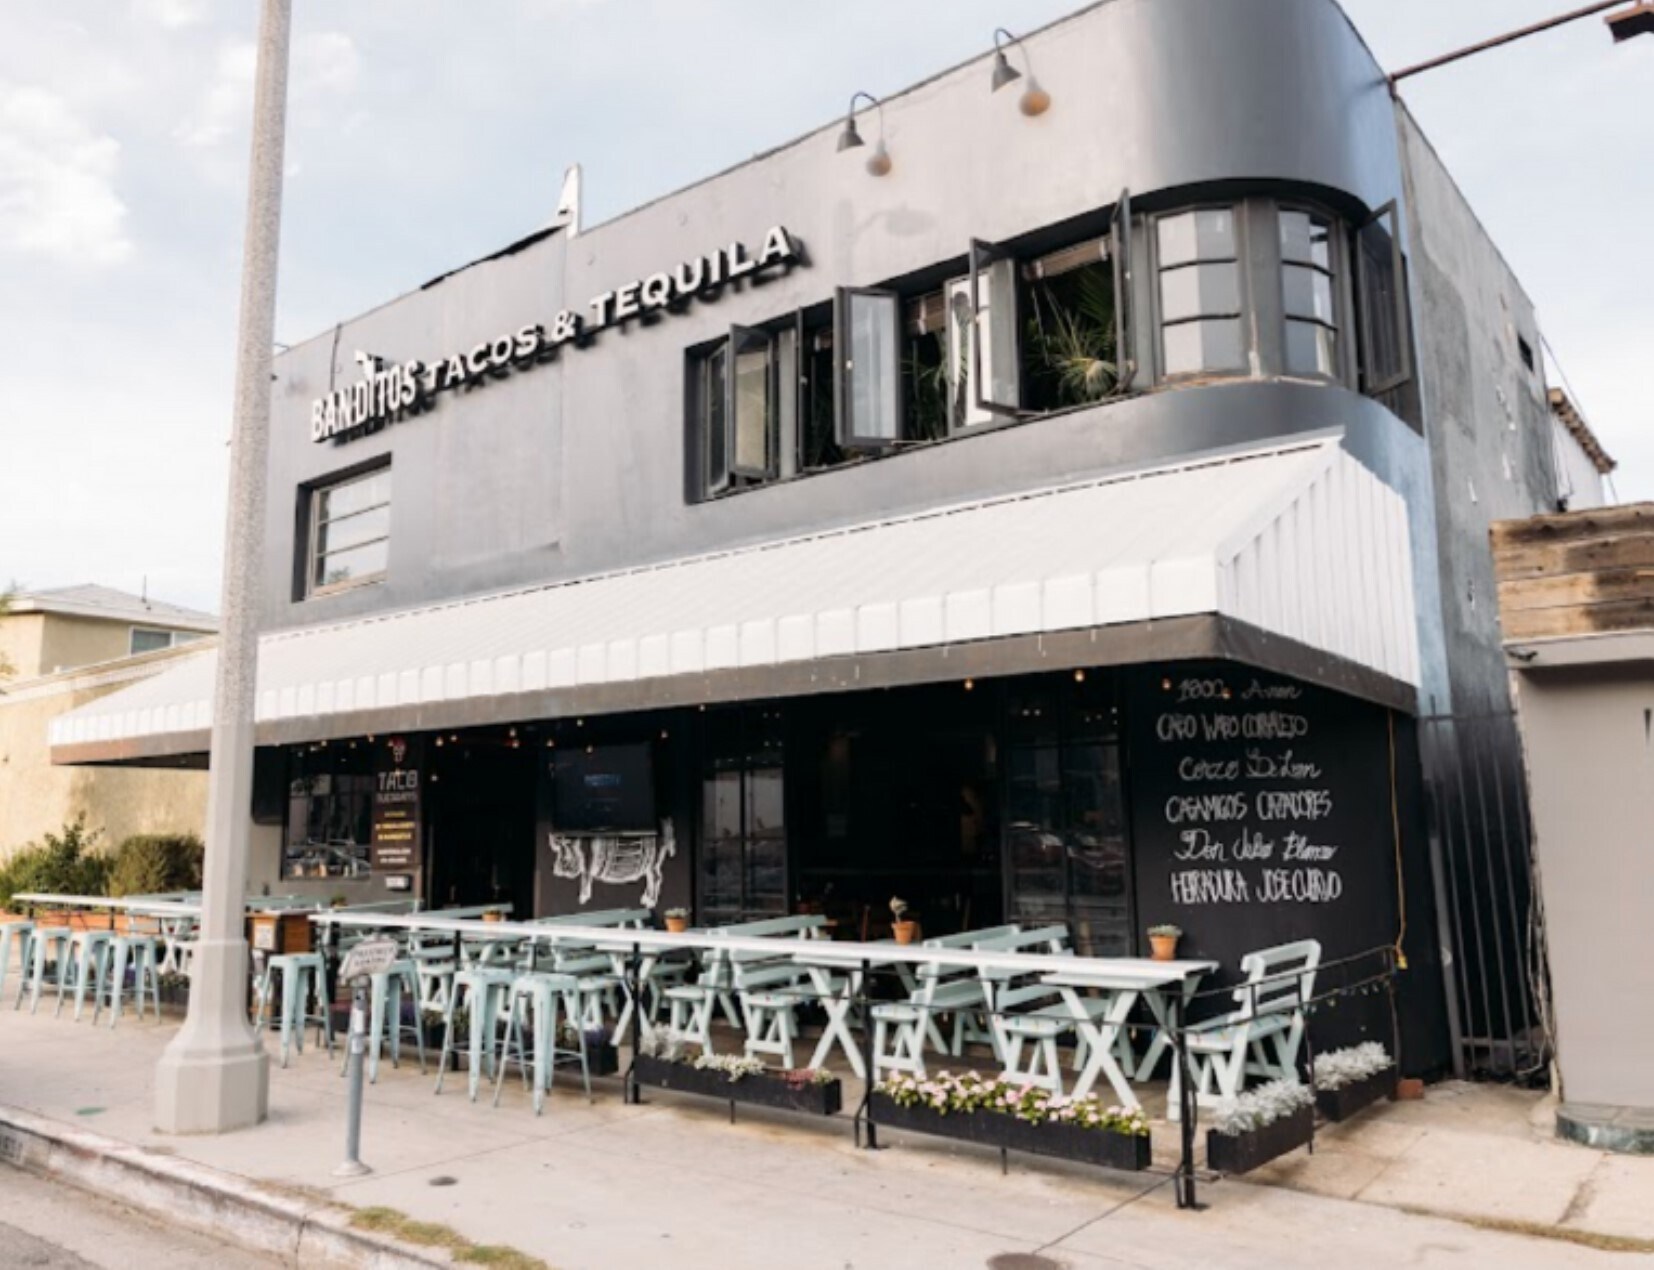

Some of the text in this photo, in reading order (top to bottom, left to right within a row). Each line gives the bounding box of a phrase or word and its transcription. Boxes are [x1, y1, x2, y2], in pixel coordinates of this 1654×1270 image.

[311, 225, 792, 442] BANDITOS TACOS & TEQUILA
[378, 769, 418, 790] TACO
[1174, 828, 1228, 862] Don
